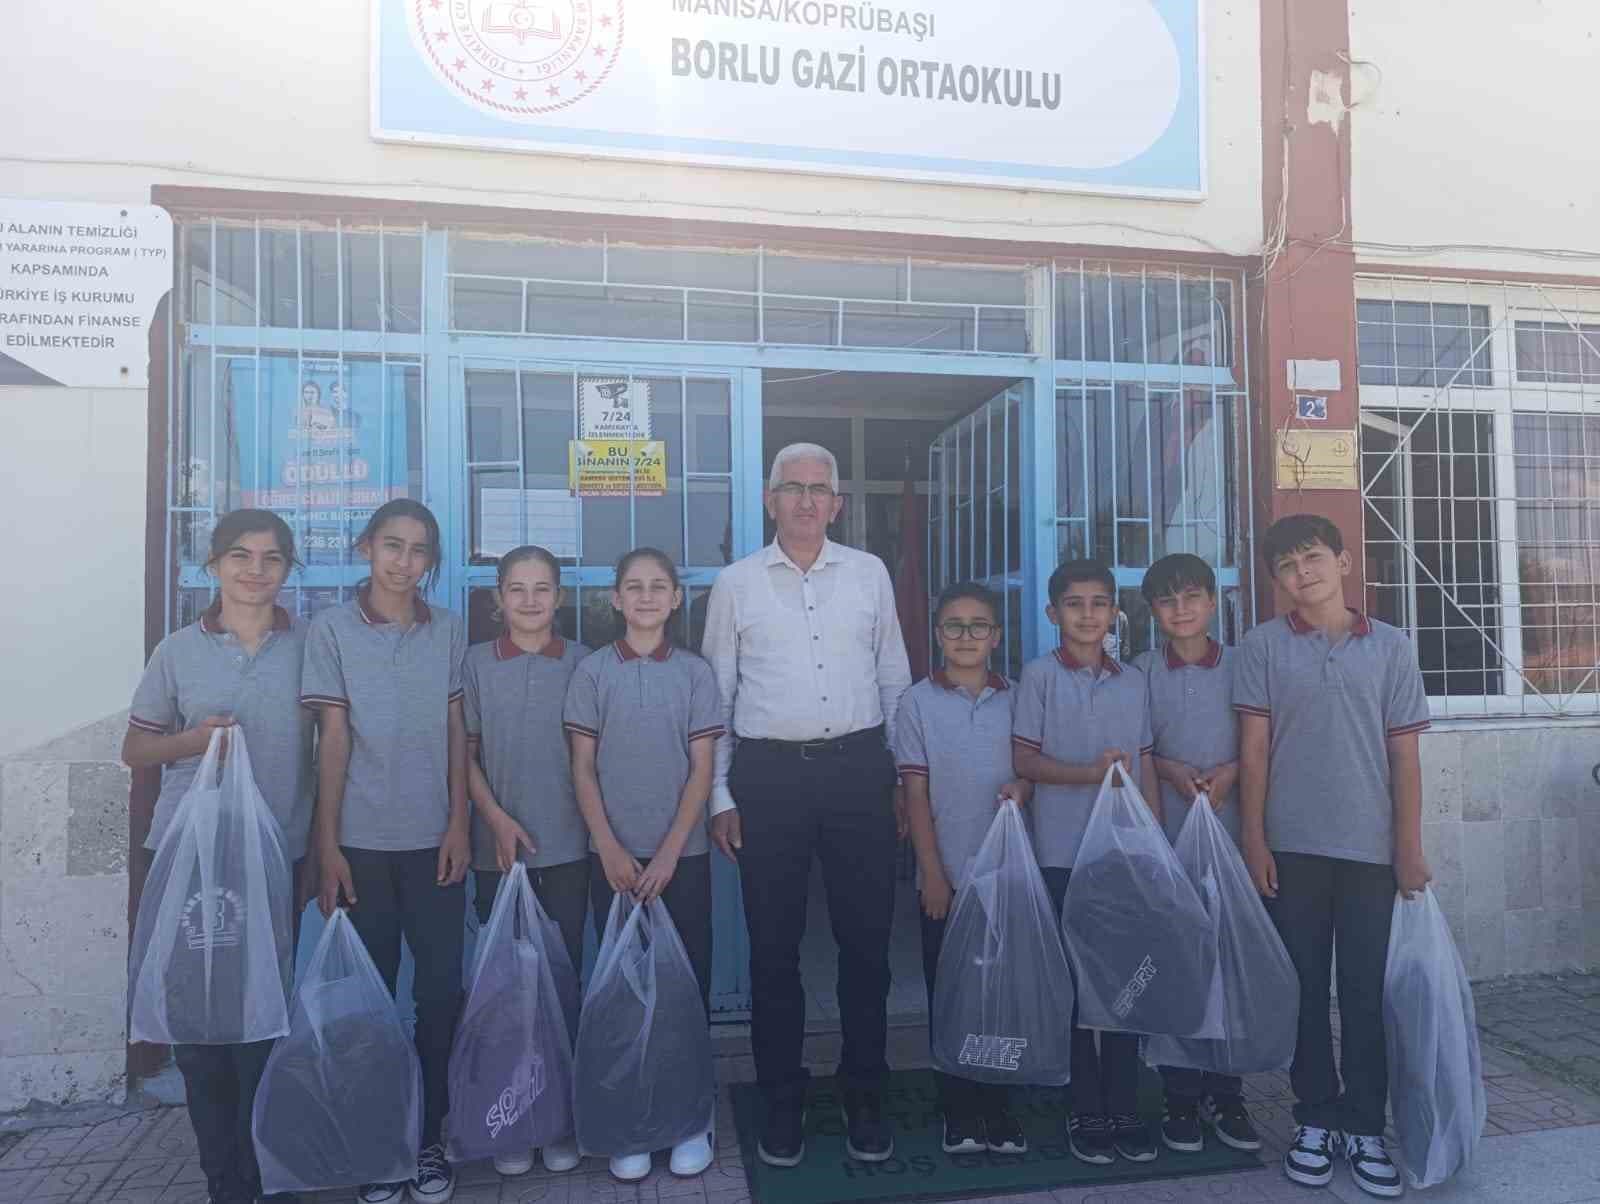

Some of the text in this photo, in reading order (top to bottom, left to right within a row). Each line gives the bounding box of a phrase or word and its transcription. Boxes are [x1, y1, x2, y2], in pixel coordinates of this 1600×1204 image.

[672, 37, 1062, 110] BORLU GAZİ ORTAOKULU
[8, 223, 63, 236] ALANIN
[67, 225, 137, 238] TEMİZLİĞİ
[6, 242, 67, 254] YARARINA
[70, 246, 130, 257] PROGRAM
[11, 263, 109, 277] KAPSAMINDA
[54, 288, 67, 304] İŞ
[72, 291, 135, 304] KURUMU
[78, 314, 141, 327] FİNANSE
[6, 334, 115, 348] EDİLMEKTEDİR
[601, 411, 631, 422] 7/24
[608, 446, 629, 458] BU
[633, 456, 661, 467] 7/24
